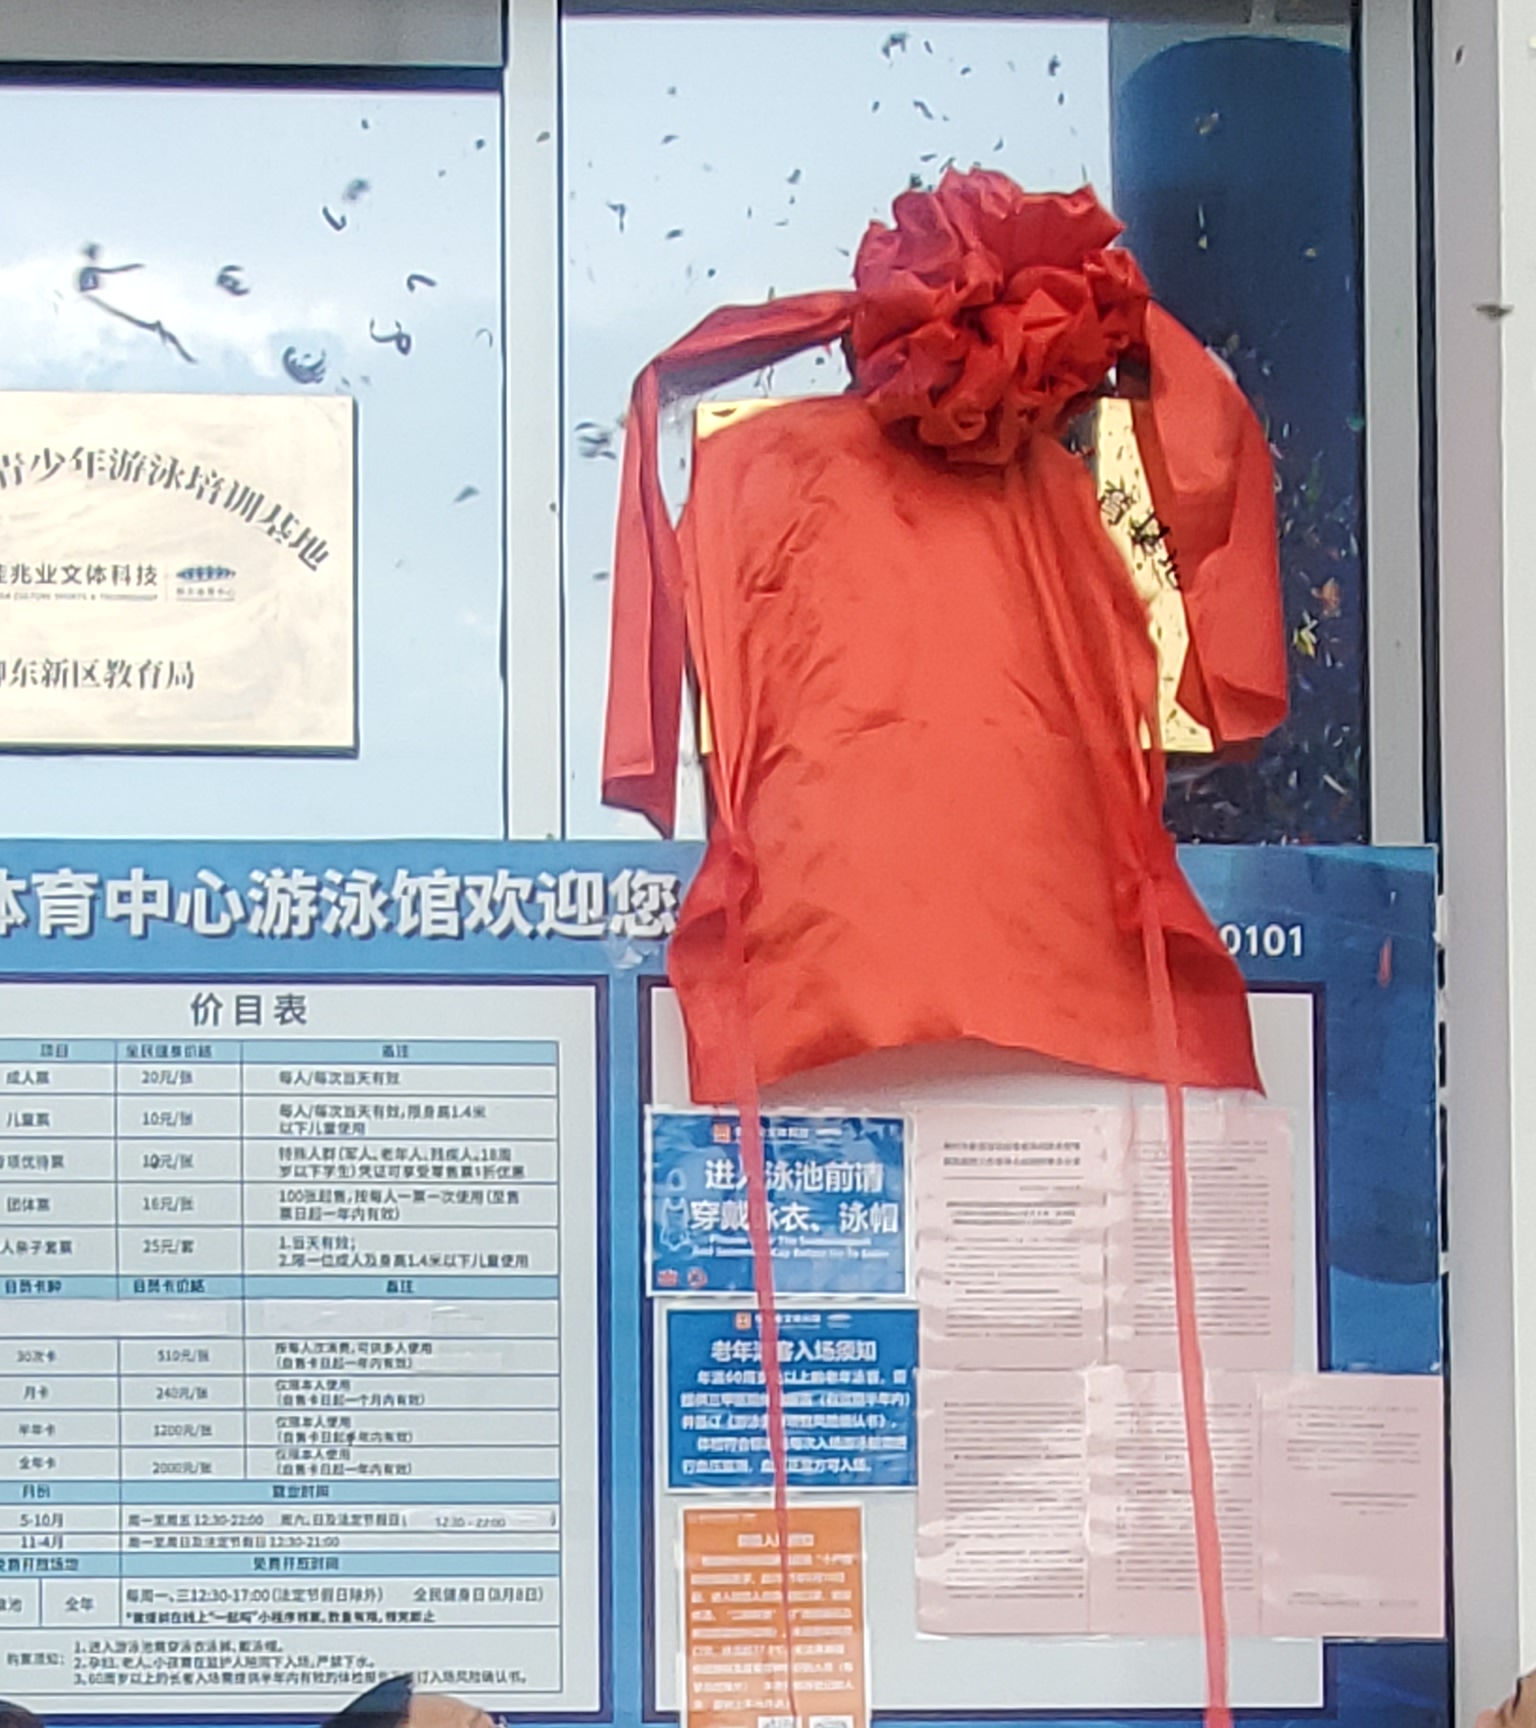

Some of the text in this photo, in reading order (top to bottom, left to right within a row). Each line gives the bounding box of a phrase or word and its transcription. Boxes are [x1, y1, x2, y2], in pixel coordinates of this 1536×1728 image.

[190, 992, 309, 1028] 价目表
[6, 1070, 51, 1085] 成人票
[6, 1112, 51, 1128] 儿童票
[6, 1197, 51, 1213] 团体票
[711, 1340, 877, 1363] 老年客入场须知
